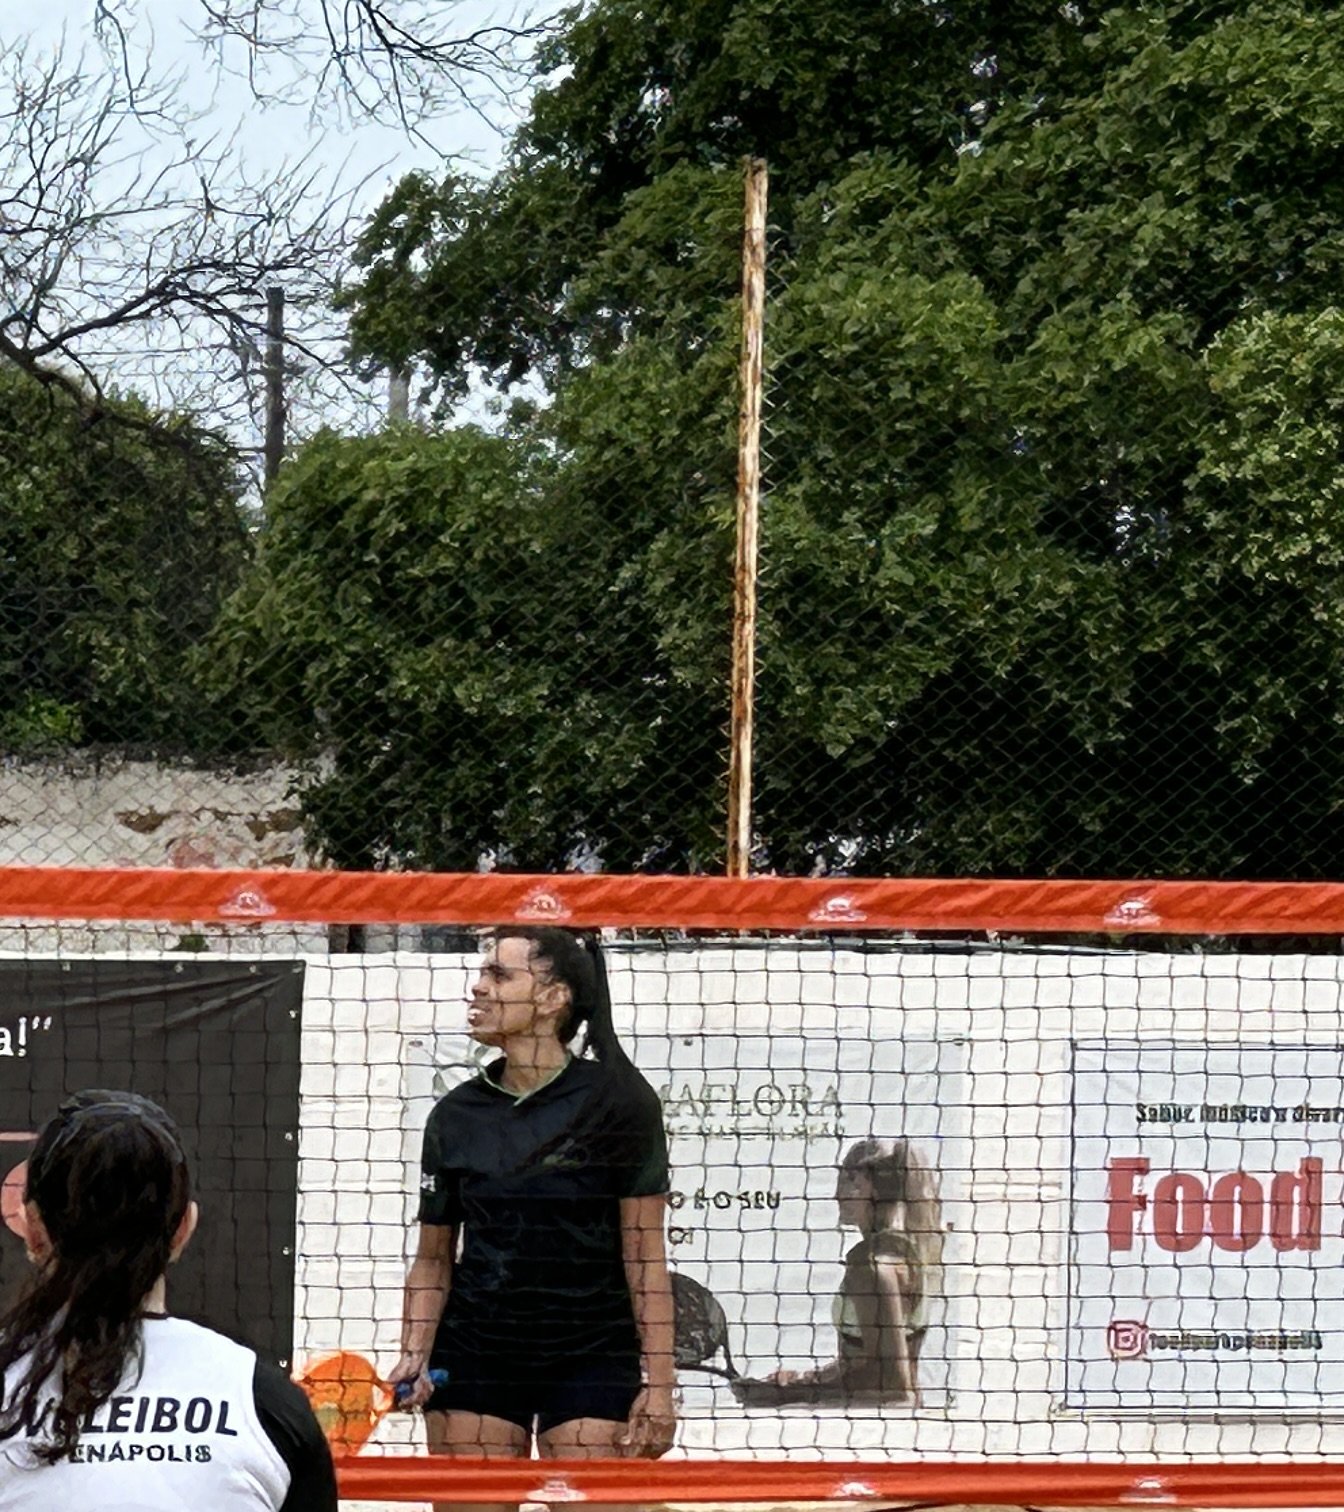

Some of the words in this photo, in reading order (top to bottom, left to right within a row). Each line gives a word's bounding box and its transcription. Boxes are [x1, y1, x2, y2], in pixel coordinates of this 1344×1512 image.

[1107, 1156, 1324, 1253] Food
[20, 1396, 239, 1437] VLEIBOL
[67, 1440, 213, 1464] ENÁPOLIS
